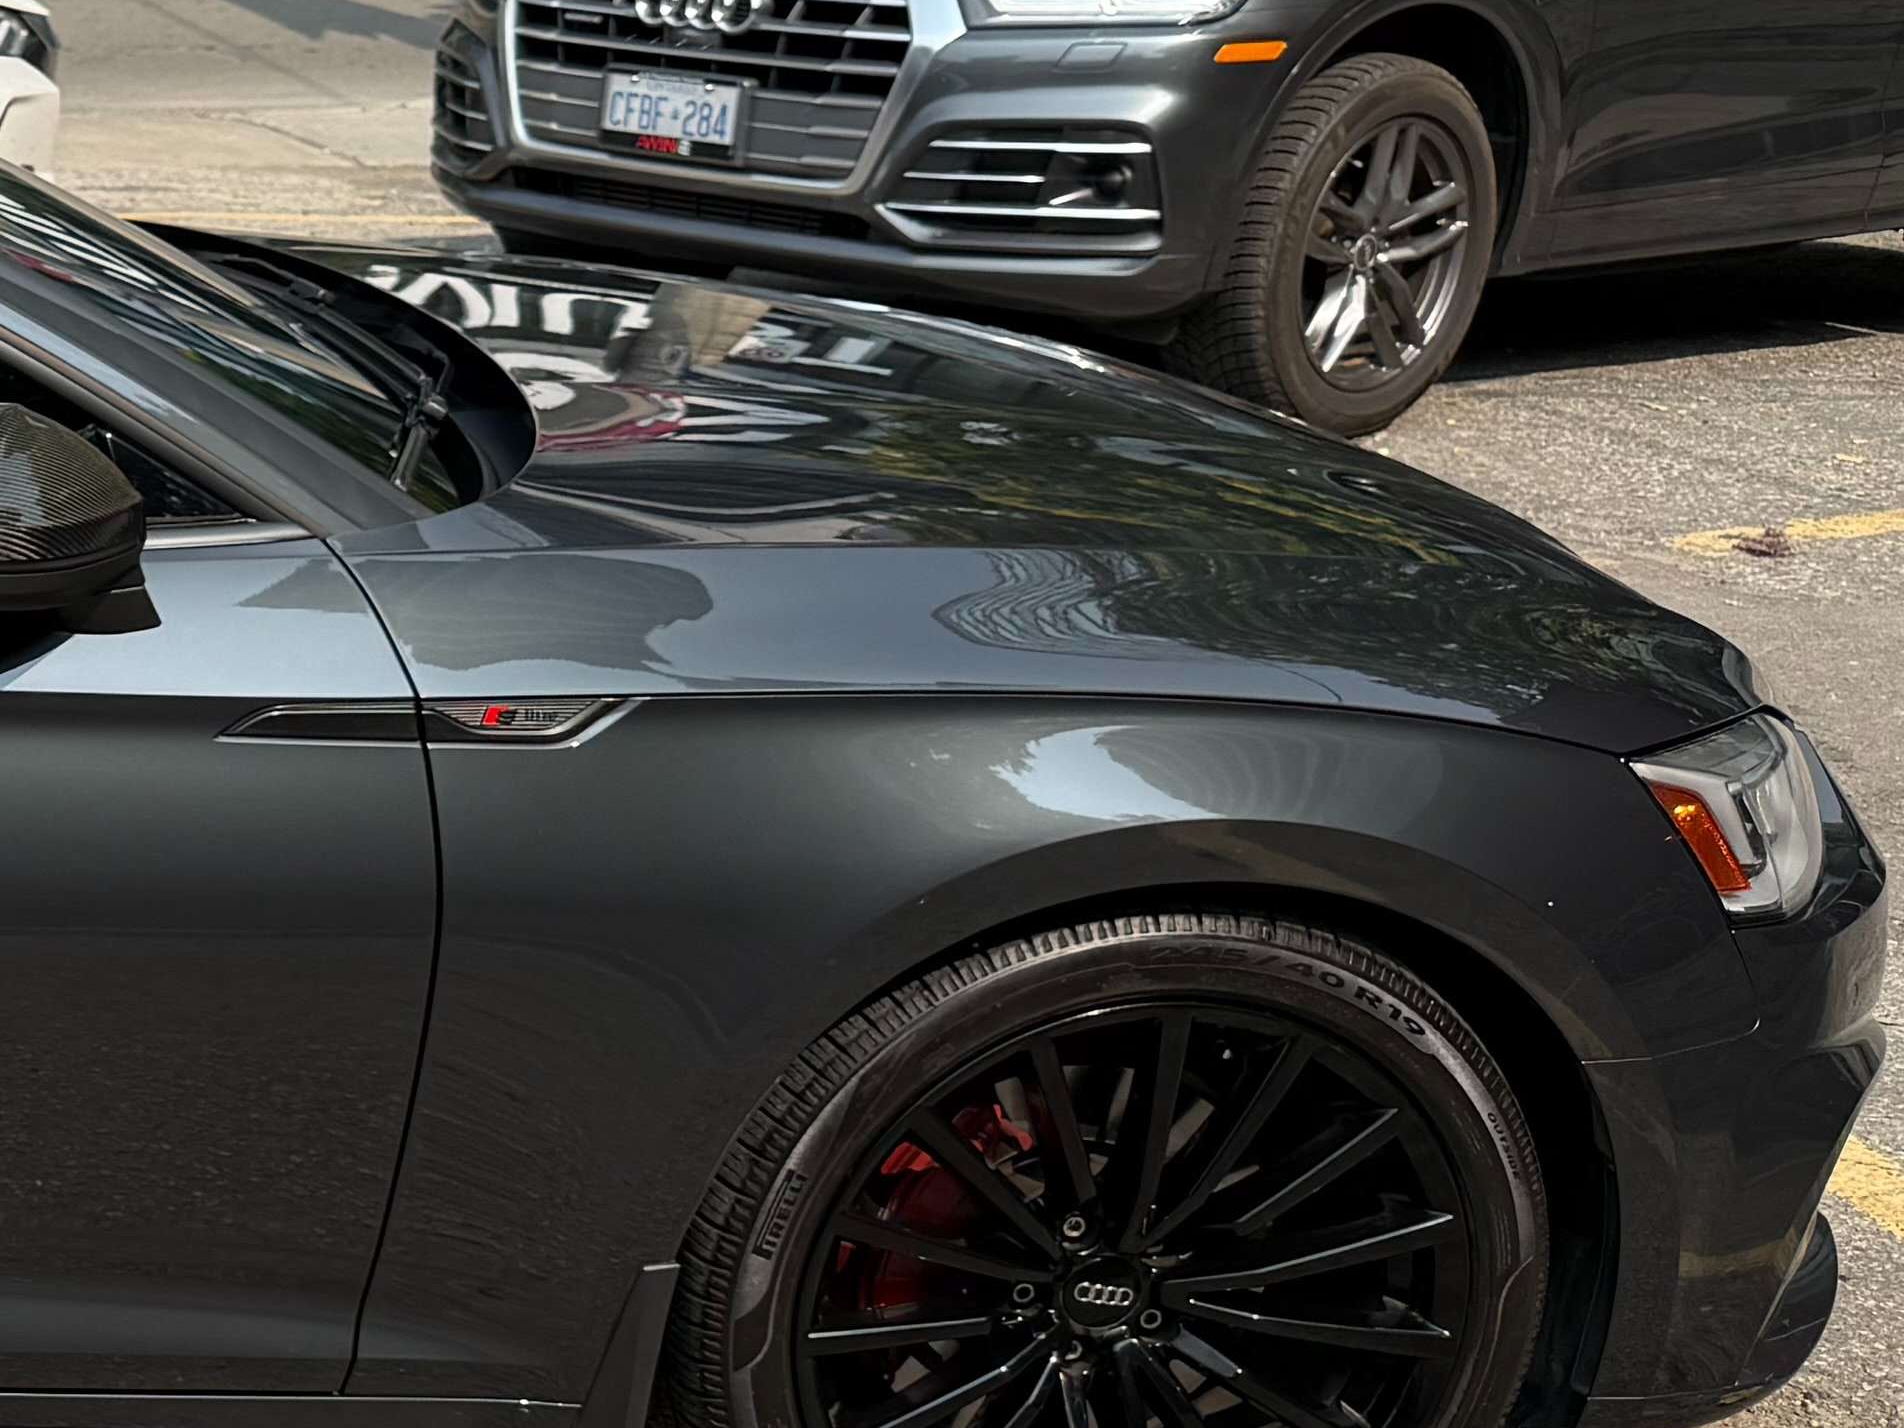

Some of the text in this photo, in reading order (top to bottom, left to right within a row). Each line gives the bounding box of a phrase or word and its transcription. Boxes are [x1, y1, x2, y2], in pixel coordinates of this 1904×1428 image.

[681, 100, 728, 139] 284
[1353, 987, 1427, 1037] R19
[752, 1168, 809, 1261] PIRELLI
